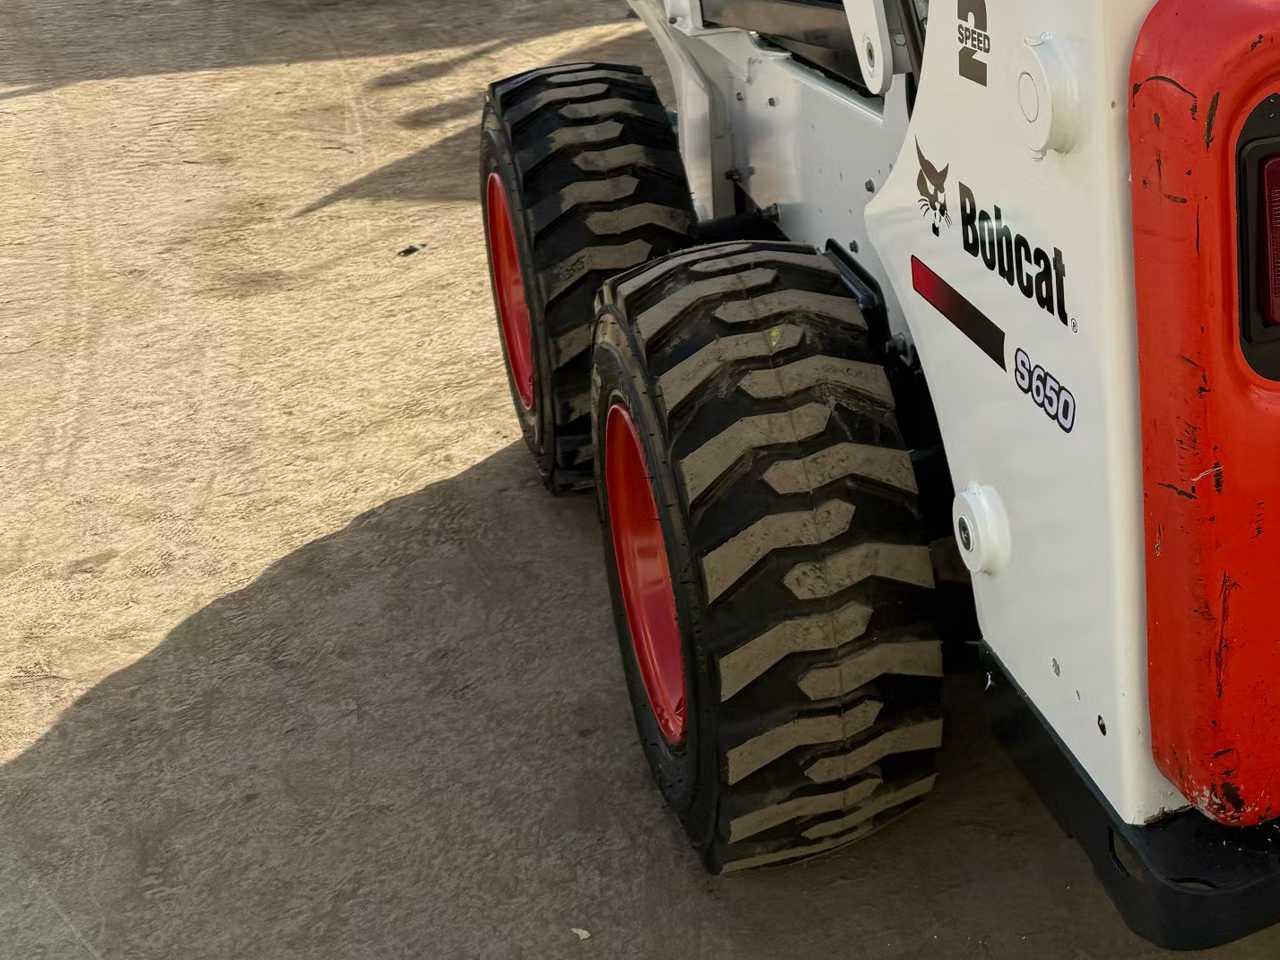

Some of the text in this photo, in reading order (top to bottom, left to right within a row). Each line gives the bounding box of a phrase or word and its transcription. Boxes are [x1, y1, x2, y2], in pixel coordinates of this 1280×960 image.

[957, 23, 991, 54] SPEED
[958, 181, 1069, 326] Bobcat
[1014, 347, 1076, 433] S650
